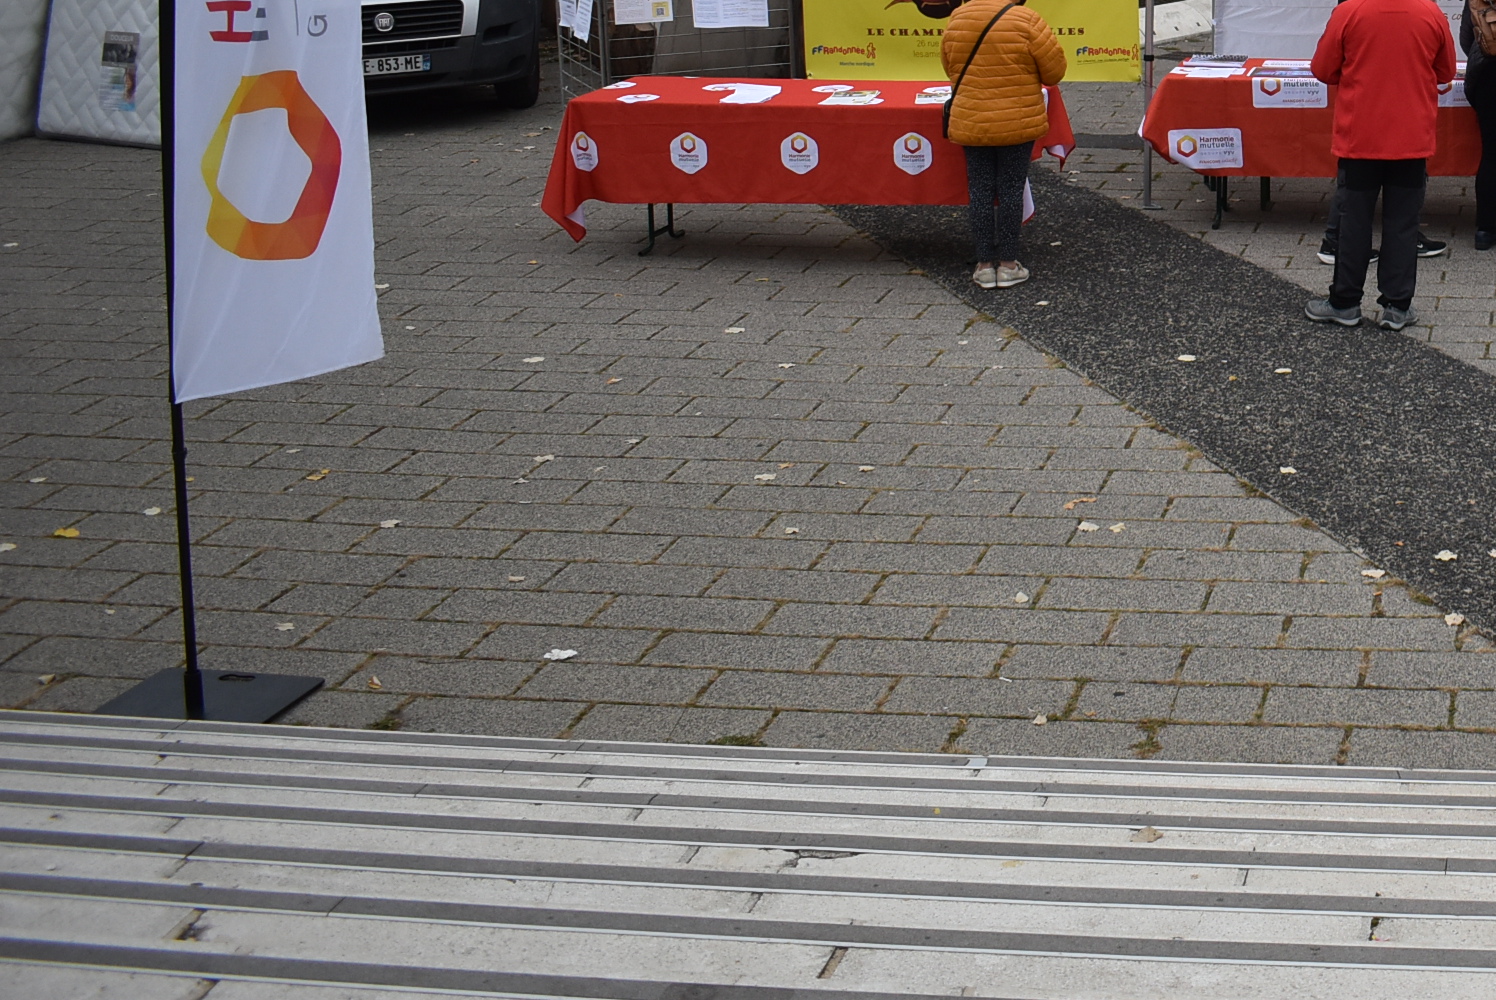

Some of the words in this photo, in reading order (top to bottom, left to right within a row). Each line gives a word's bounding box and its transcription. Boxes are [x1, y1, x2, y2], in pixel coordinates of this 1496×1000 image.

[378, 17, 391, 27] FIAT
[866, 28, 884, 36] LE
[916, 39, 926, 48] 26
[927, 40, 940, 48] rue
[1283, 80, 1320, 88] mutuelle
